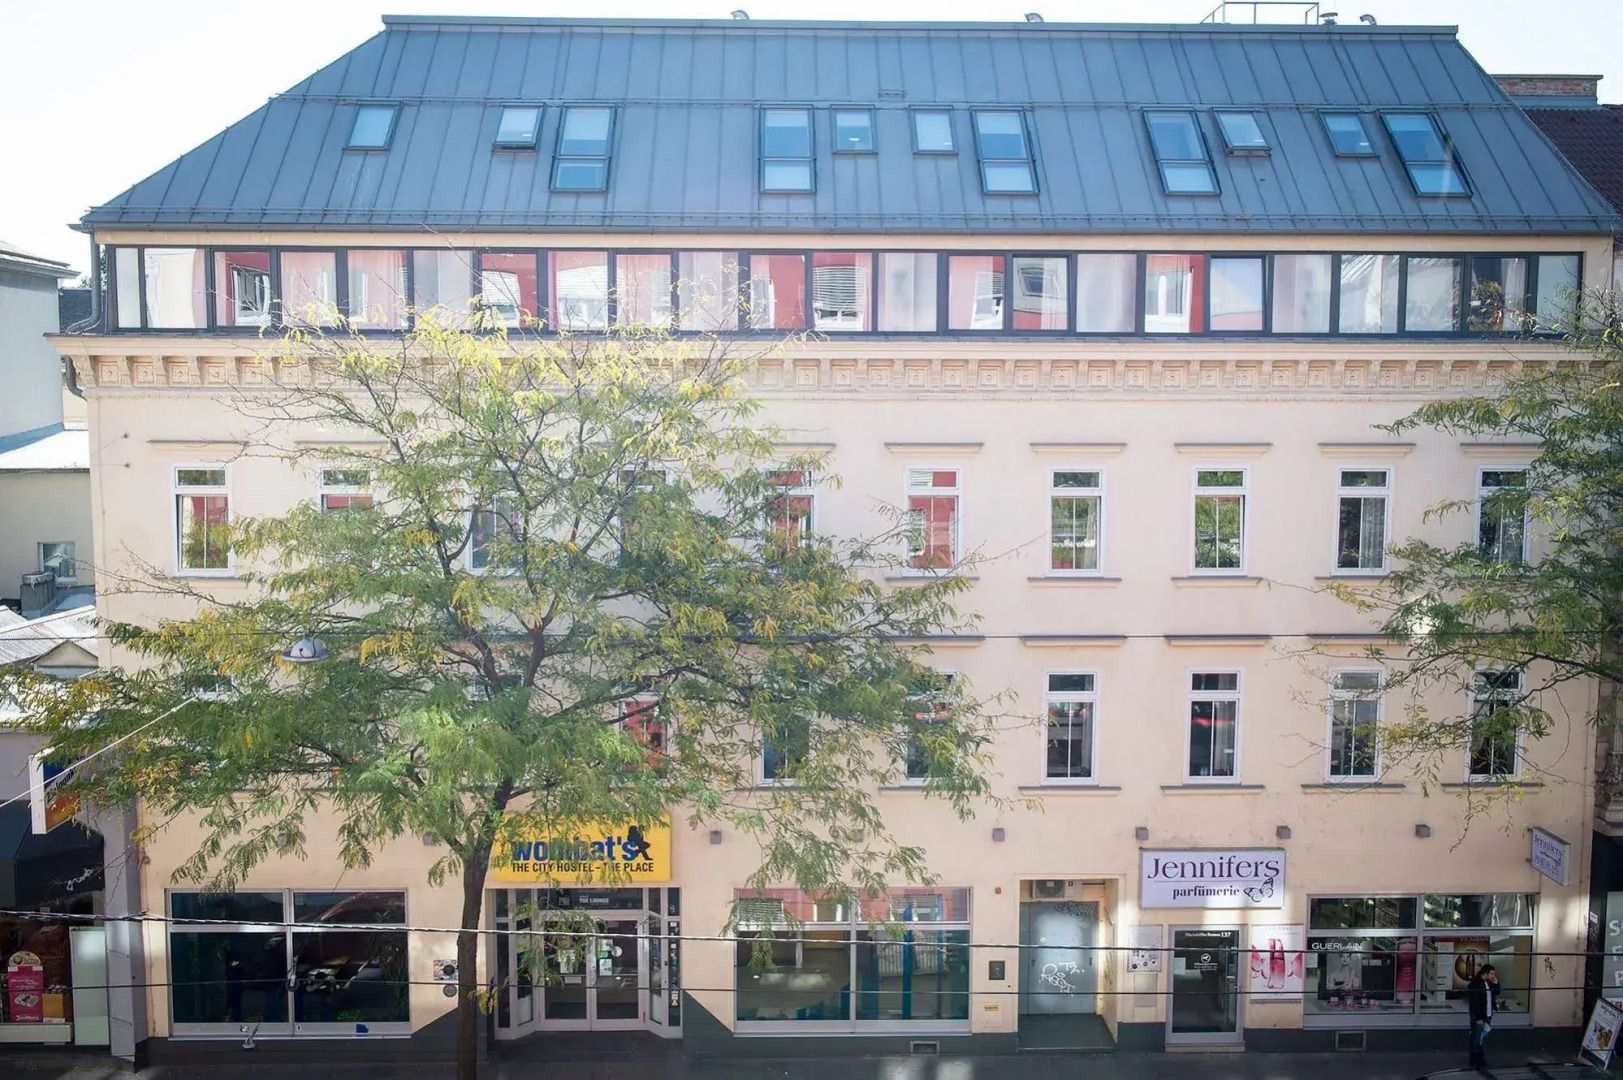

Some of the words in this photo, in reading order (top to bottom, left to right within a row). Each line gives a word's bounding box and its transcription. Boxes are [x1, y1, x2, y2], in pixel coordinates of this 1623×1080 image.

[513, 863, 529, 872] THE
[533, 863, 554, 872] CITY
[557, 863, 594, 872] HOSTEL
[623, 863, 654, 872] PLACE
[1147, 855, 1280, 879] Jennifers
[1173, 885, 1240, 900] parfümerie
[1311, 942, 1362, 950] GUERLAIN
